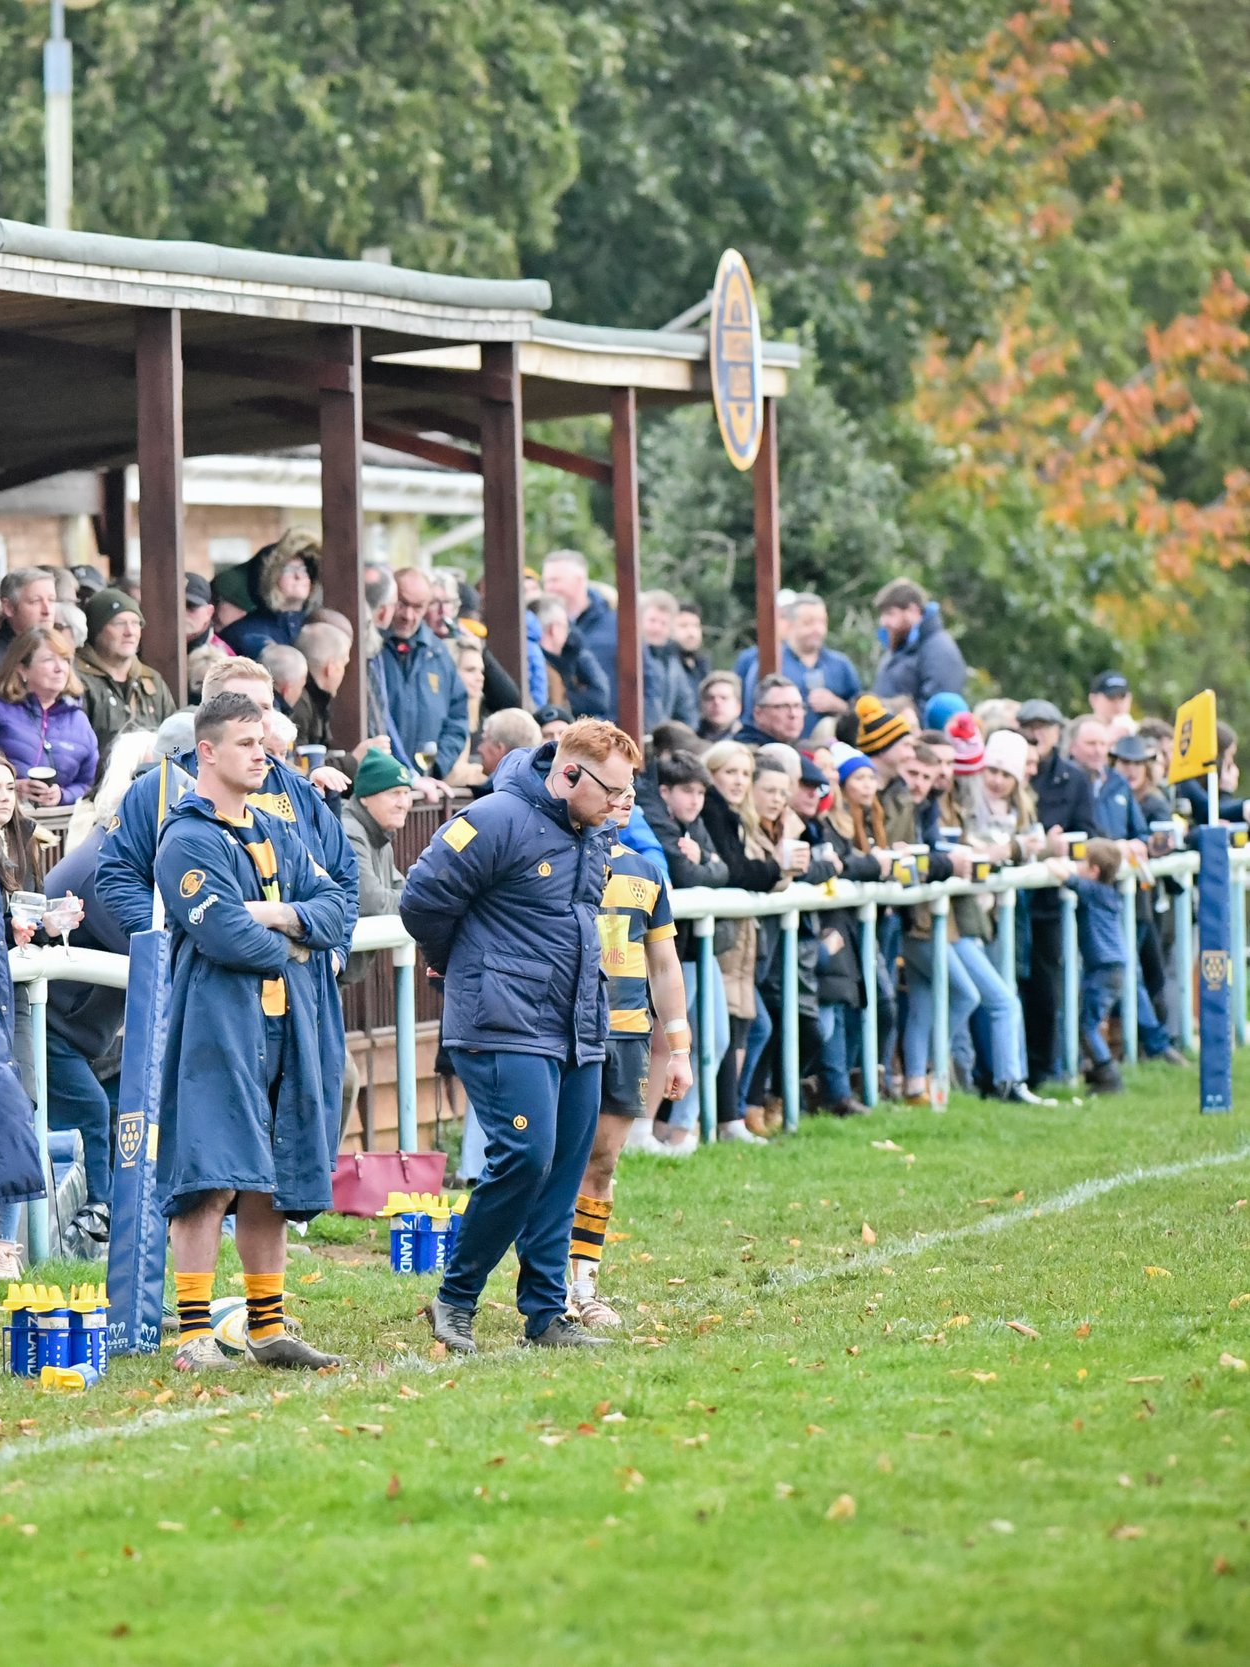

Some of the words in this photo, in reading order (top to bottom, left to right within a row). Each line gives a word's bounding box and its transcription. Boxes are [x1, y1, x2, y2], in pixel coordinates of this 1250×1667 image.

[601, 946, 625, 965] vills
[400, 1233, 413, 1273] LAND
[27, 1331, 37, 1378] LAND
